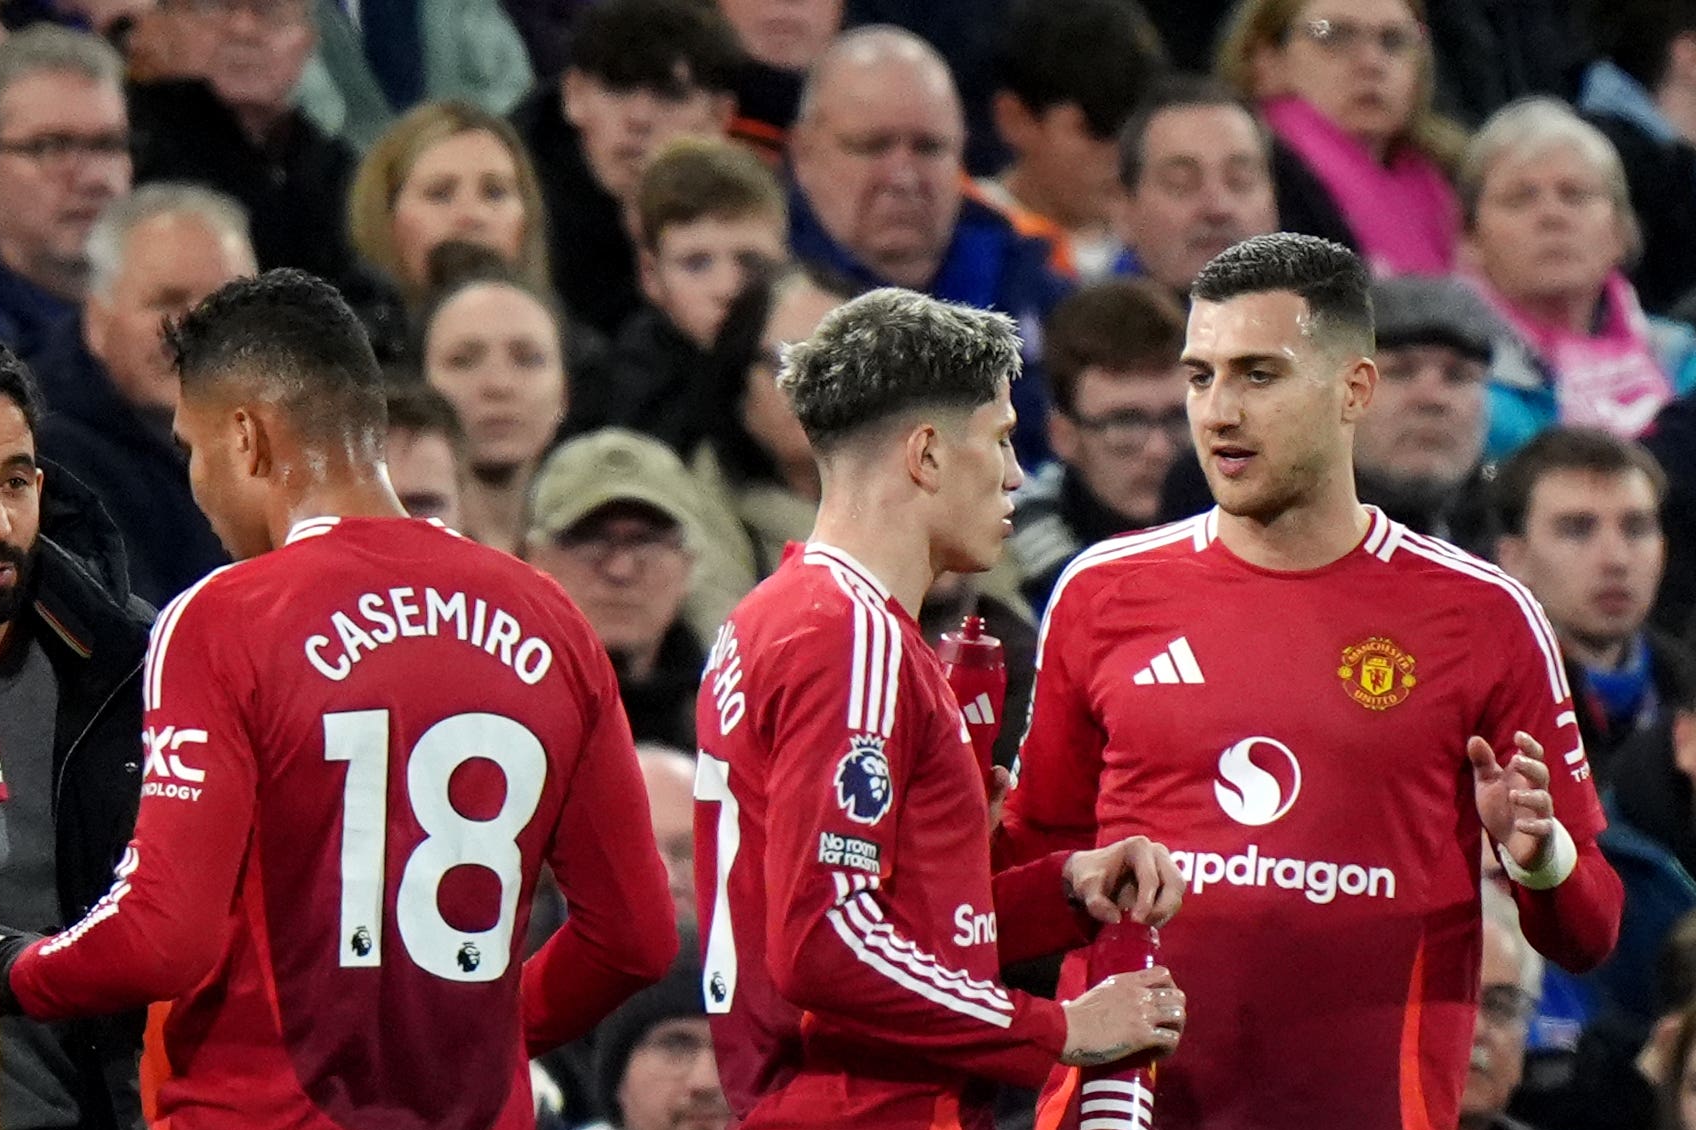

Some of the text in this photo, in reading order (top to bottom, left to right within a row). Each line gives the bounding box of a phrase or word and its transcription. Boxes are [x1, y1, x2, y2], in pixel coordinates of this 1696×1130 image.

[305, 587, 552, 685] CASEMIRO
[323, 709, 548, 983] 18
[821, 832, 844, 851] No
